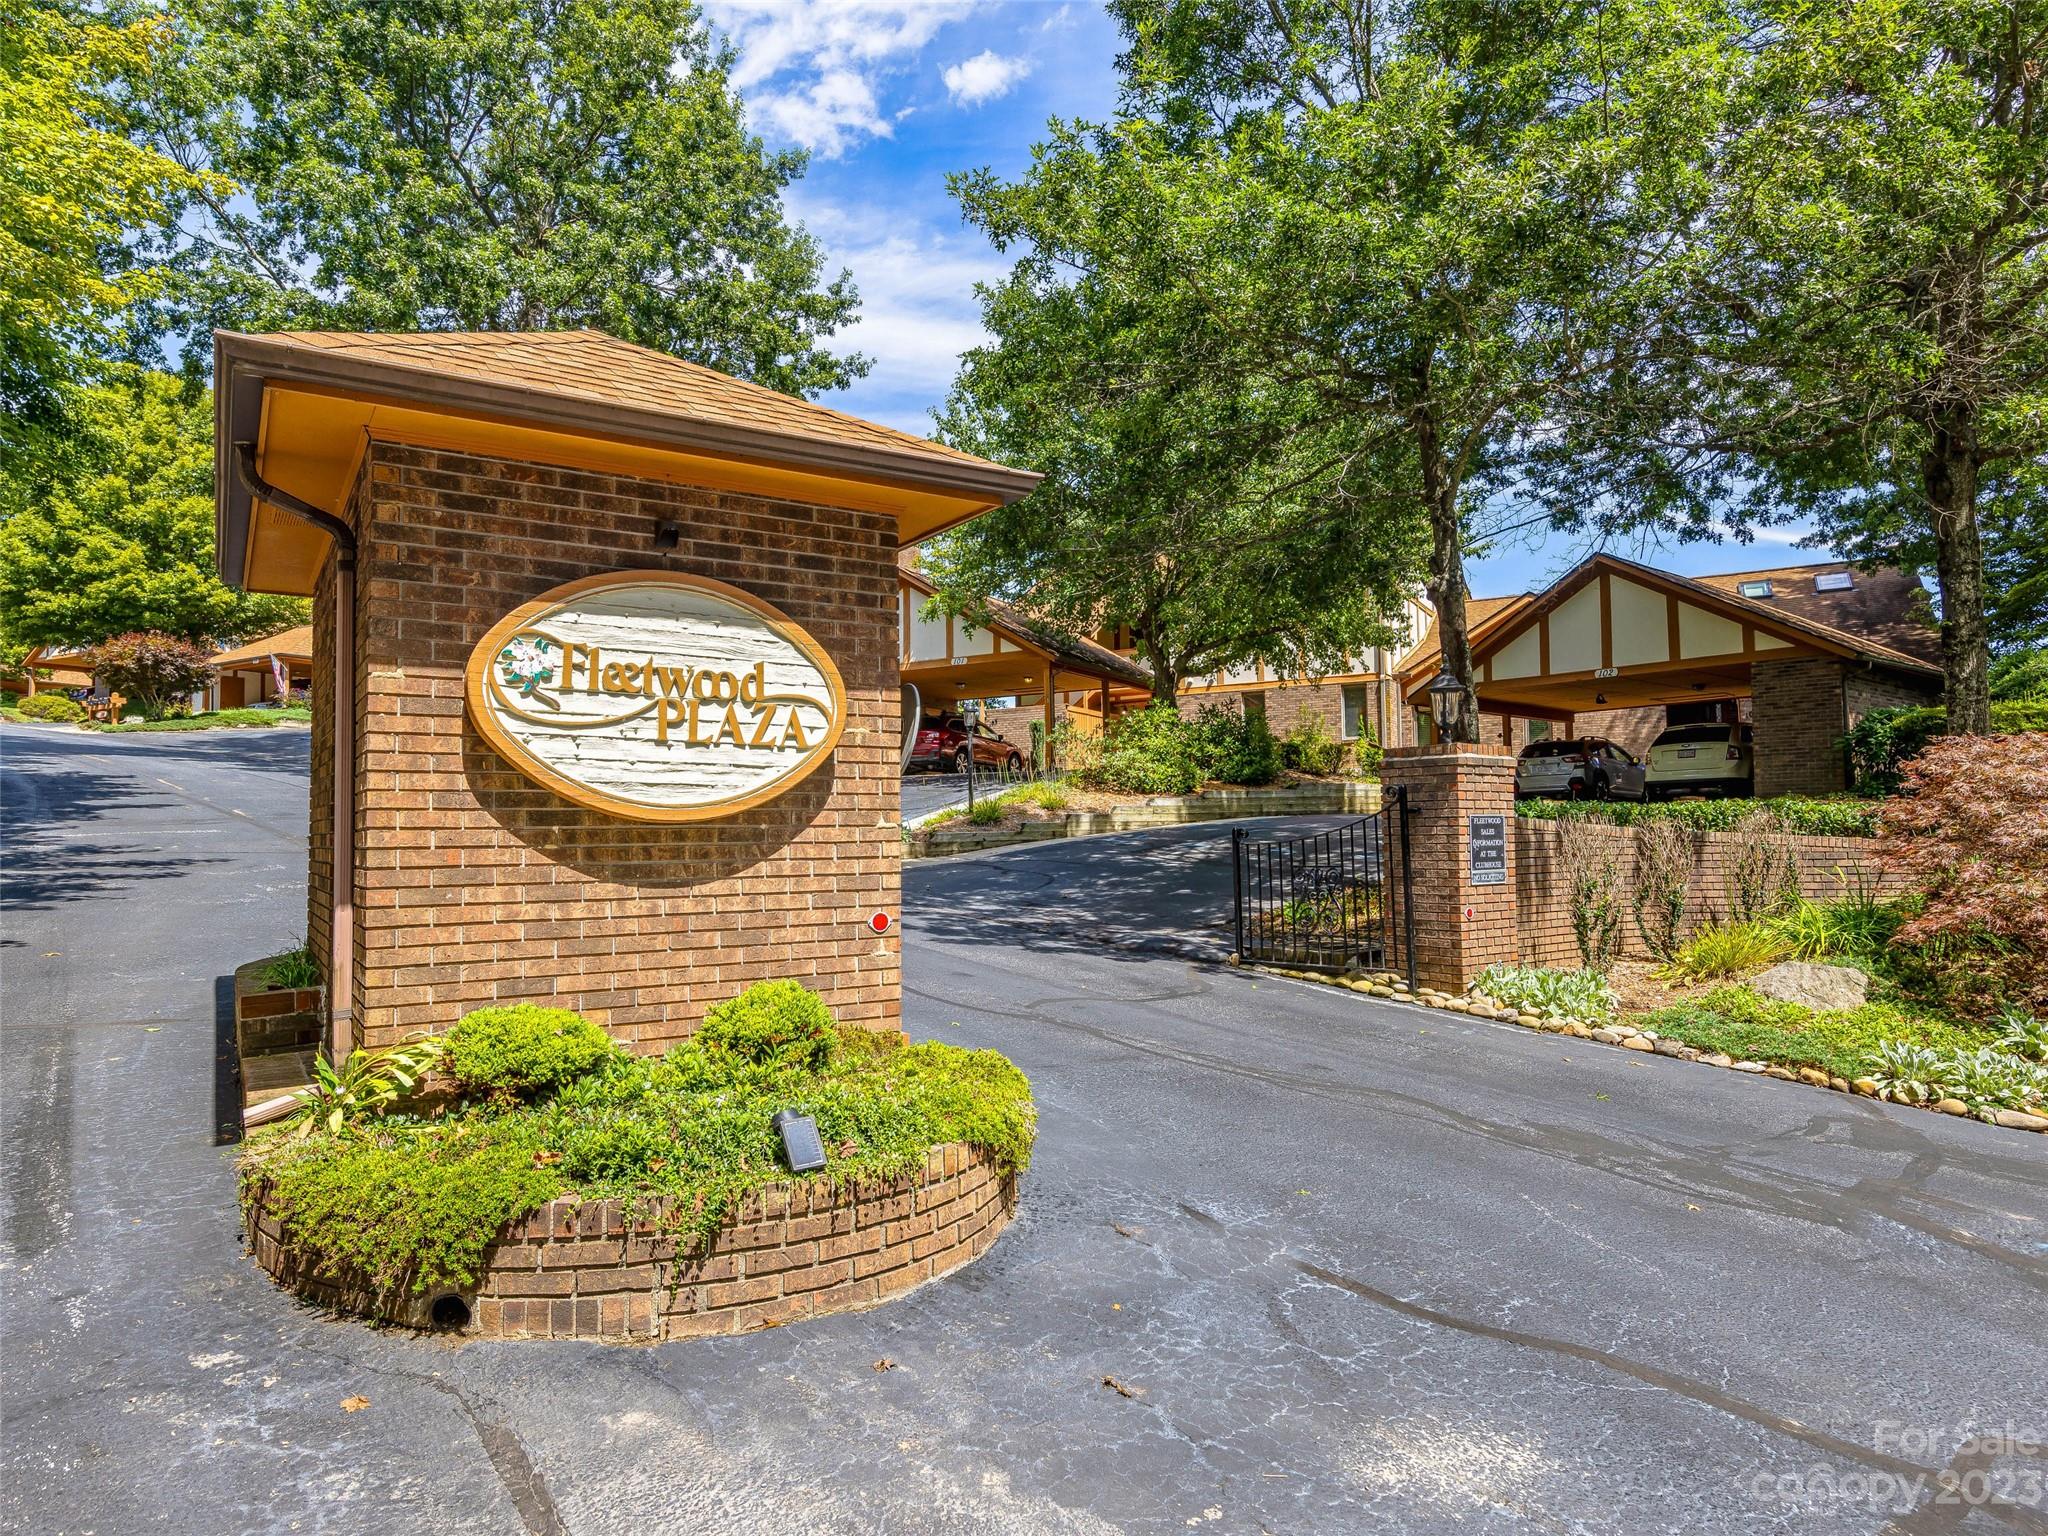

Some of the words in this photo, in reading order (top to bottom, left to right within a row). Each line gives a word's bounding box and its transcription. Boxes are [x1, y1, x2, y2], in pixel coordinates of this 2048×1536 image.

[557, 642, 766, 702] Fleetwood
[1598, 668, 1614, 677] 102
[655, 699, 809, 749] PLAZA
[1473, 817, 1502, 825] FLEETWOOD
[1480, 828, 1495, 836] SALES
